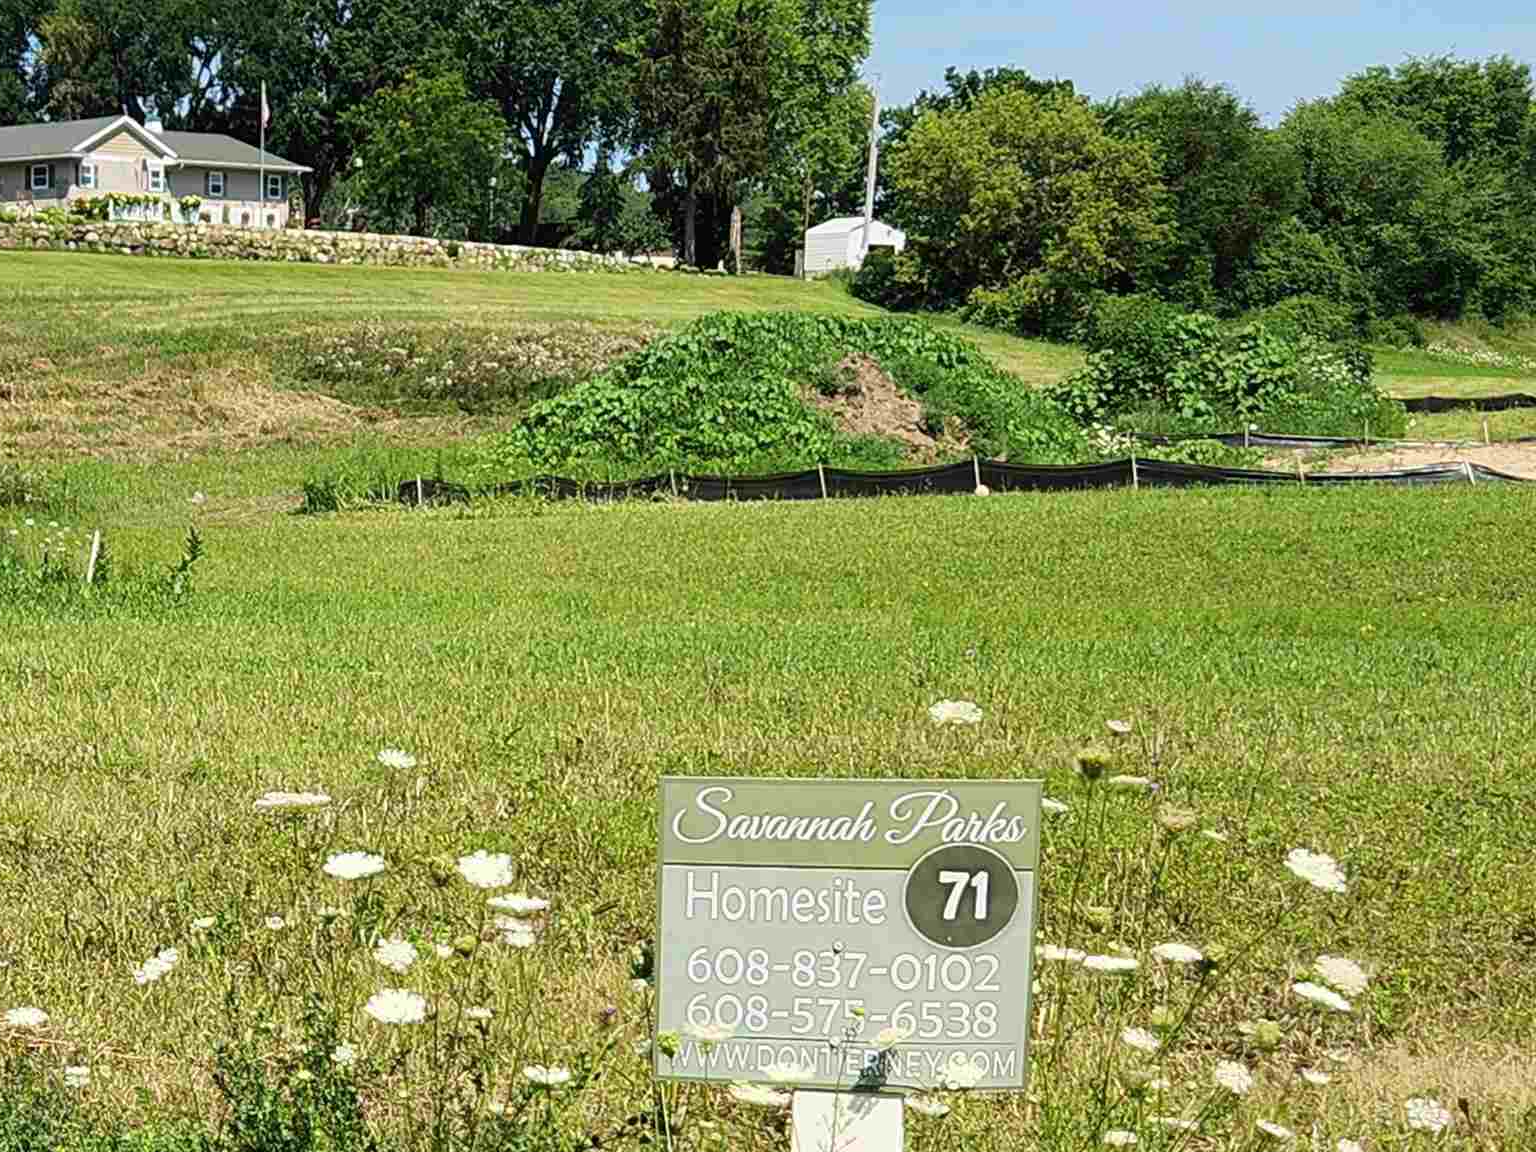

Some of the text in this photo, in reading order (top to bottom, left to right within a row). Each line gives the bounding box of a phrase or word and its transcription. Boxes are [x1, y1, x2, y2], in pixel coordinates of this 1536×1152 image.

[672, 786, 1027, 844] Savannah Parks
[686, 870, 989, 924] Homesite 71
[687, 947, 1001, 992] 608-837-0102
[687, 993, 998, 1038] 608-575-6538
[666, 1039, 1016, 1079] WWW.DONTIERNEYOM
